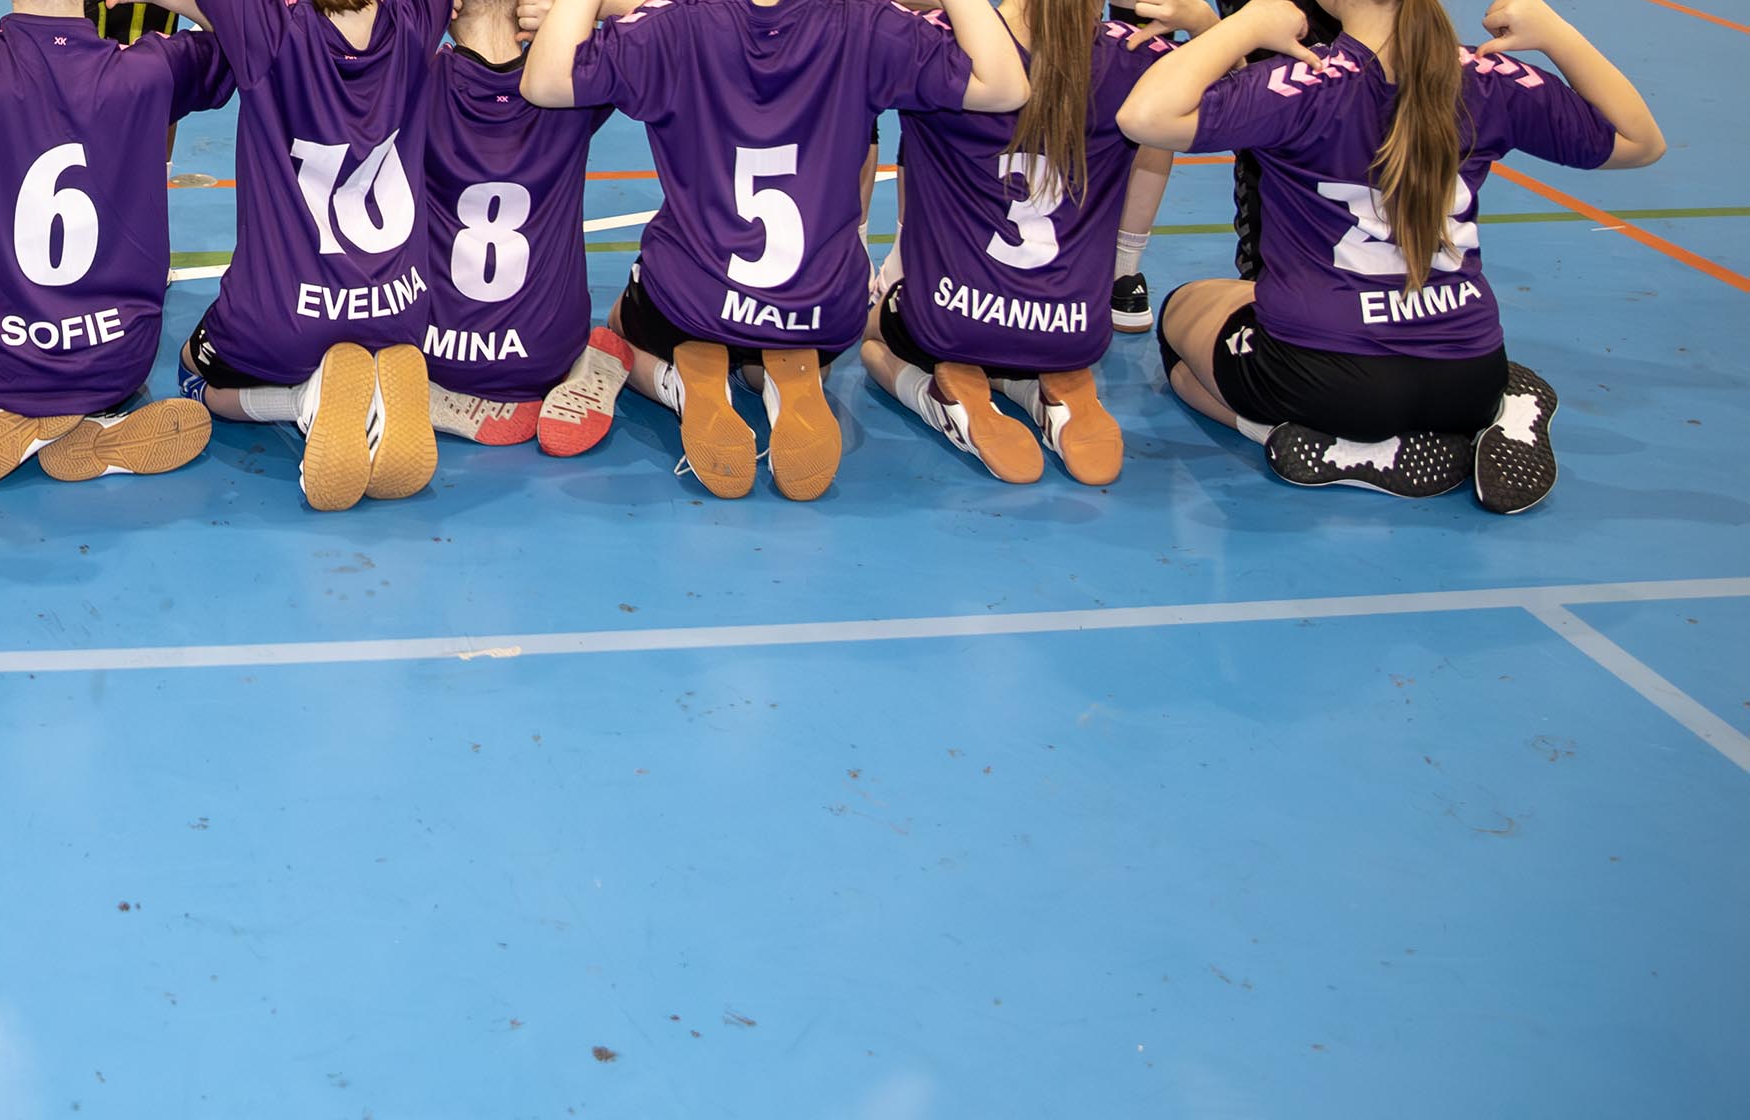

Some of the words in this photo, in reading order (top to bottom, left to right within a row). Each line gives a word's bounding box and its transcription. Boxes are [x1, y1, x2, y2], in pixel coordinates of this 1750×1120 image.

[13, 142, 99, 287] 6
[726, 143, 805, 289] 5
[985, 152, 1063, 270] 3
[450, 181, 531, 303] 8
[296, 265, 428, 321] EVELINA
[720, 290, 821, 330] MALI
[934, 276, 1087, 333] SAVANNAH
[1359, 280, 1482, 324] EMMA
[0, 307, 125, 350] SOFIE
[422, 324, 529, 362] MINA
